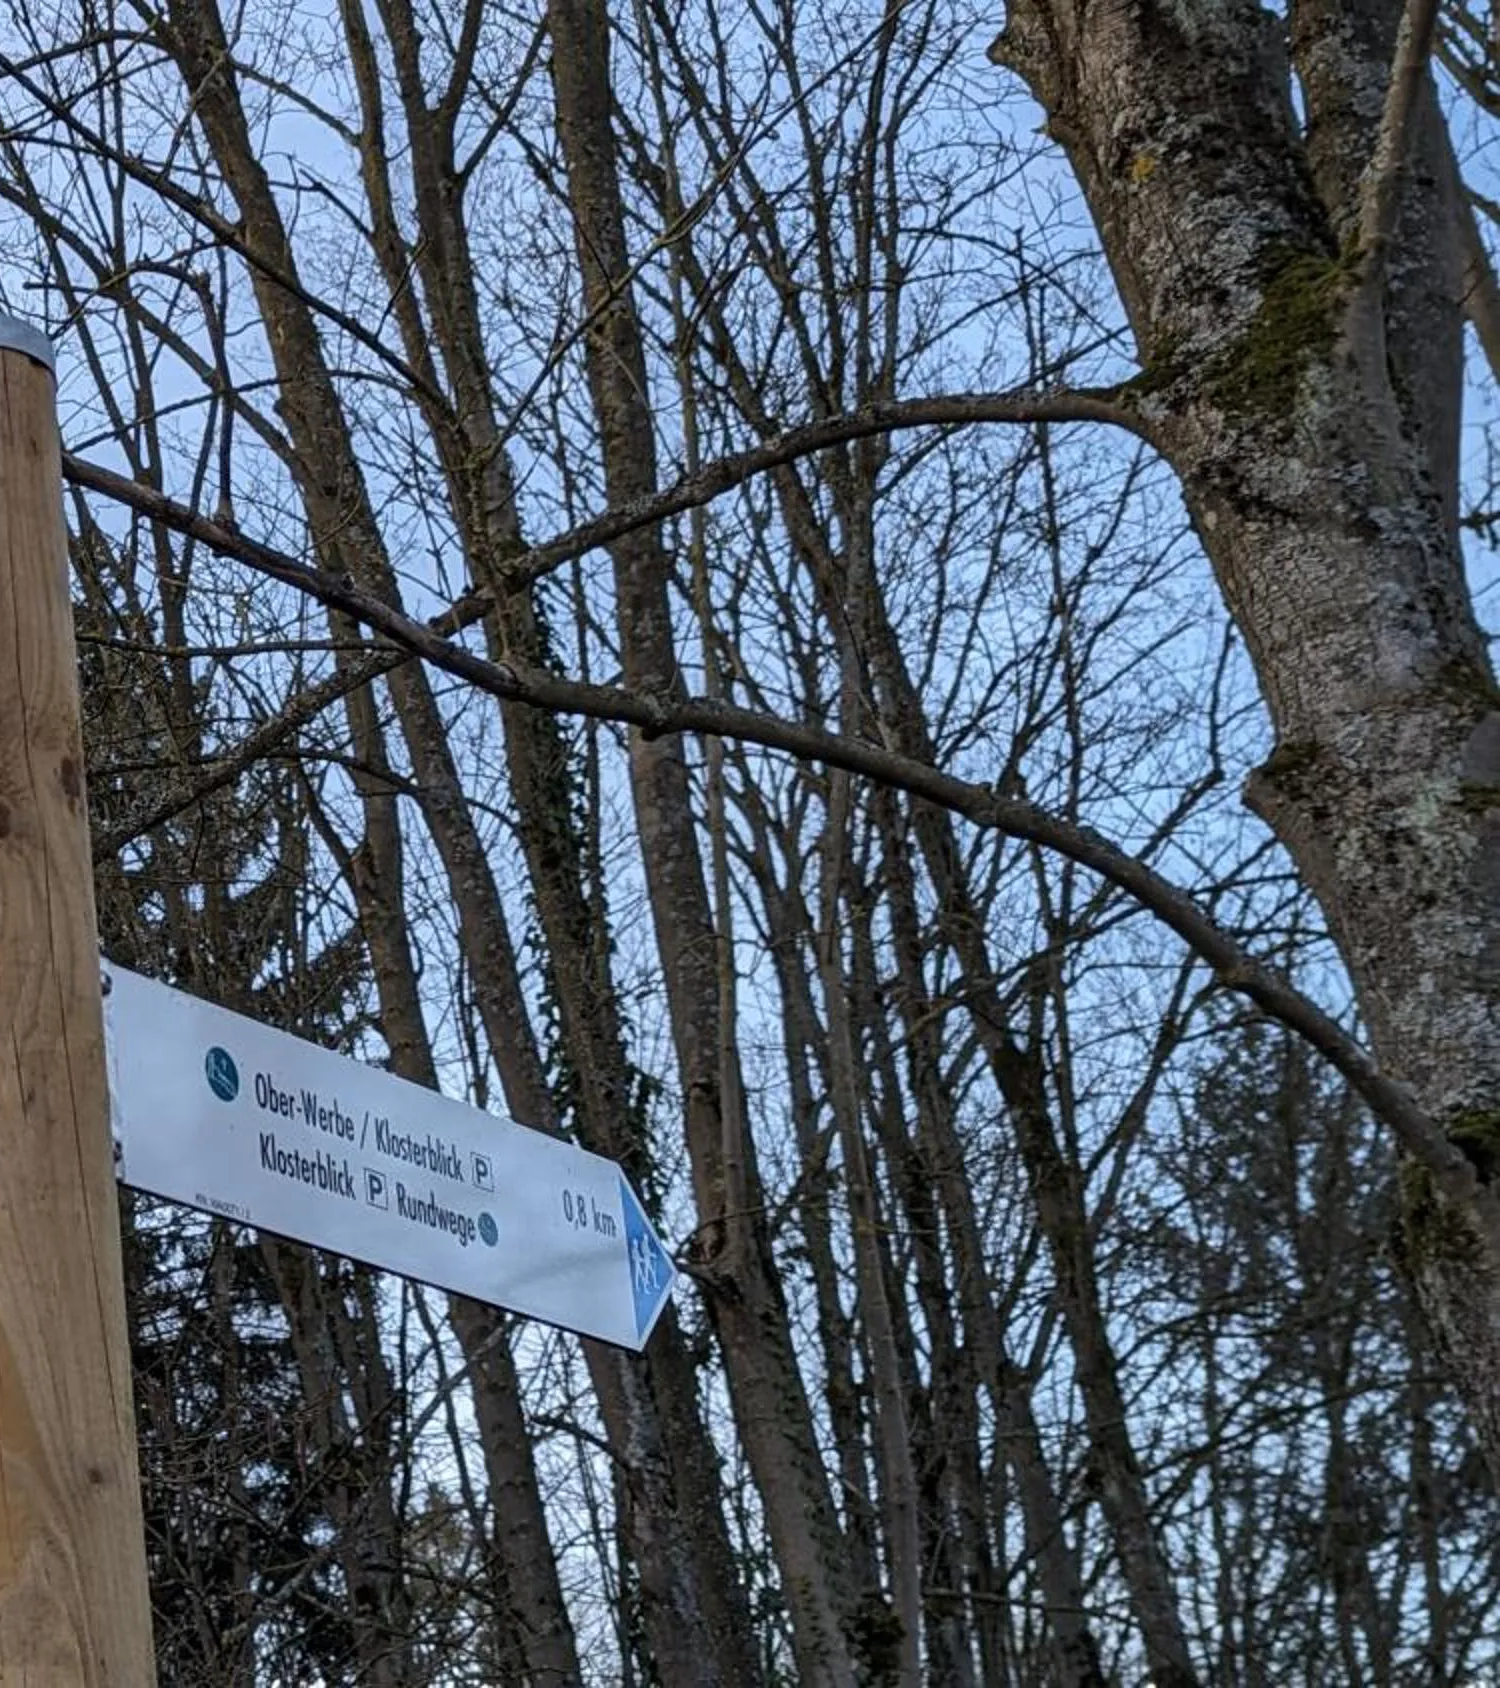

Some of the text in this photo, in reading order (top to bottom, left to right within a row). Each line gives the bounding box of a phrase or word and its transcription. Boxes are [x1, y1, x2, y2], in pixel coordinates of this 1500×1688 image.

[254, 1071, 489, 1184] Ober-Werbe / Klosterblick P
[258, 1131, 477, 1248] Klosterblick P Rundwege
[563, 1188, 617, 1238] 0,8 km
